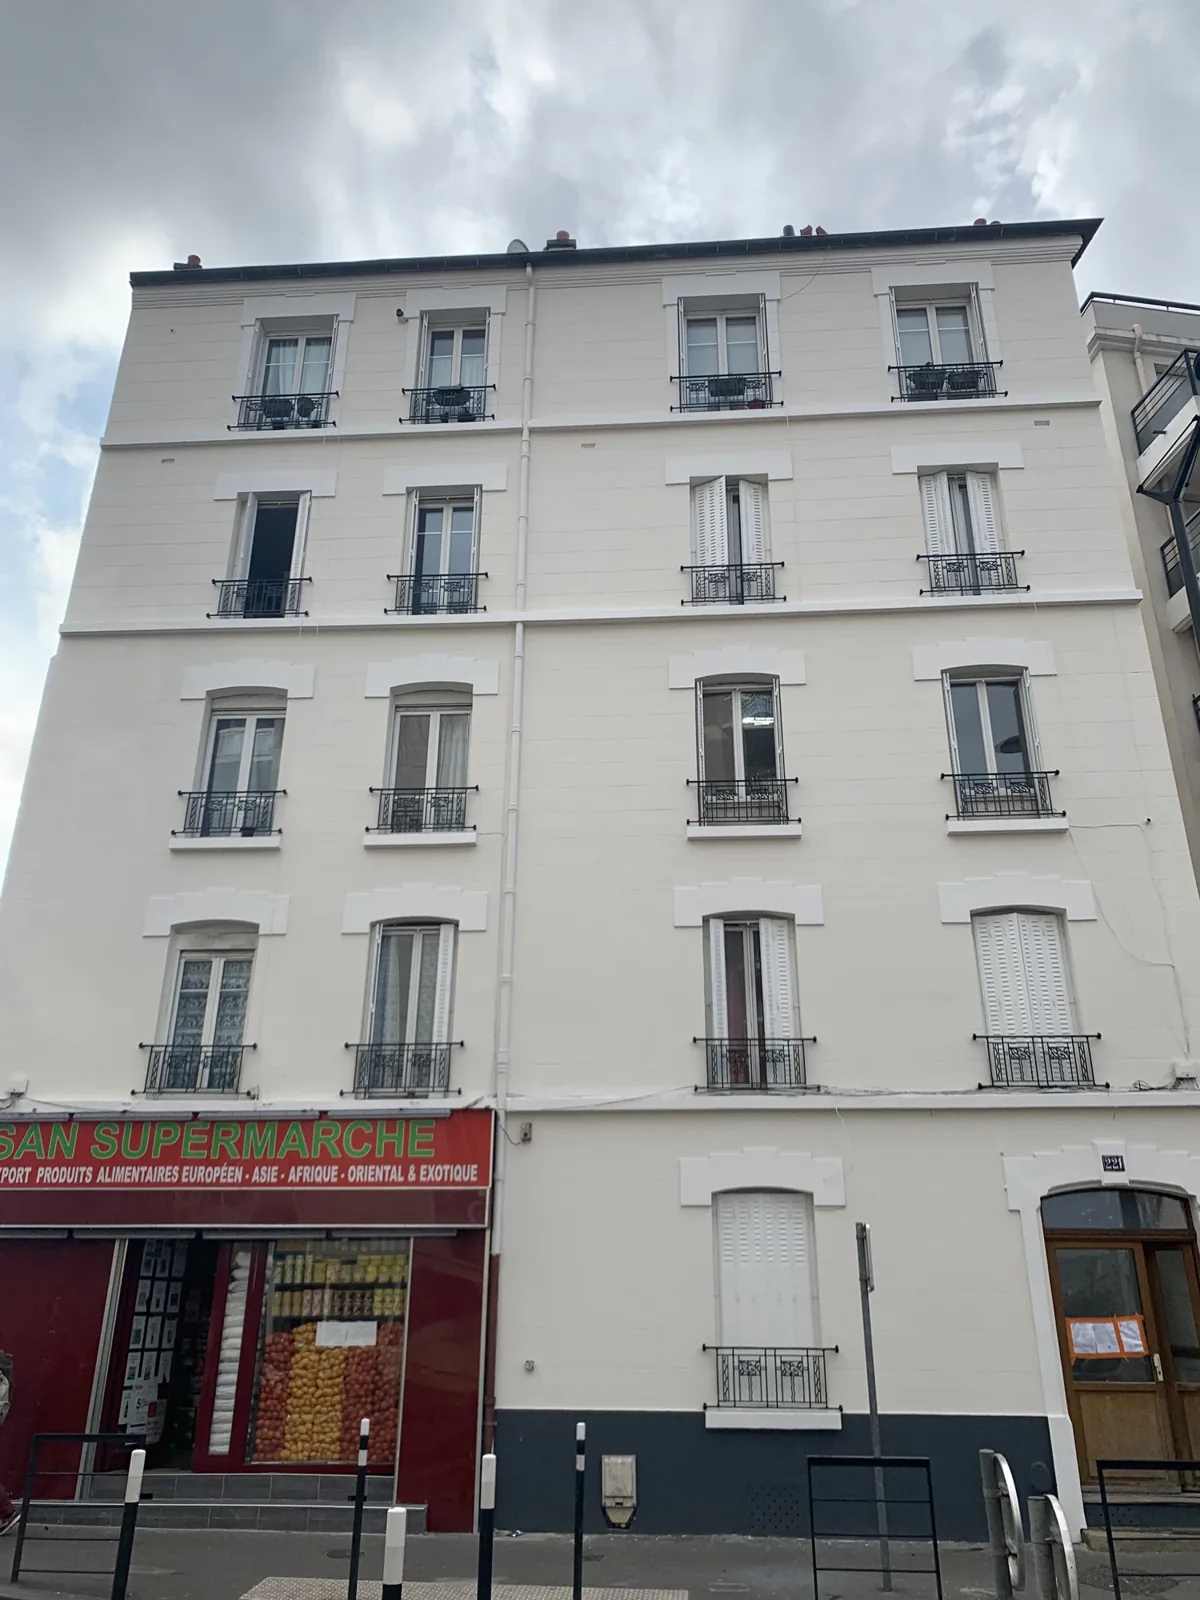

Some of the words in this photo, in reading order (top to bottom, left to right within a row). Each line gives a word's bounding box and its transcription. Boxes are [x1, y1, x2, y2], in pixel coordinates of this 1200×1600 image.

[91, 1120, 436, 1160] SUPERMARCHE
[0, 1166, 32, 1184] PORT
[36, 1166, 93, 1184] PRODUITS
[96, 1165, 179, 1183] ALIMENTAIRES
[181, 1162, 243, 1183] EUROPÉEN
[252, 1165, 279, 1183] ASIE
[287, 1165, 338, 1183] AFRIQUE
[347, 1164, 404, 1182] ORIENTAL
[407, 1164, 416, 1182] &
[419, 1164, 478, 1182] EXOTIQUE
[1104, 1157, 1122, 1170] 221
